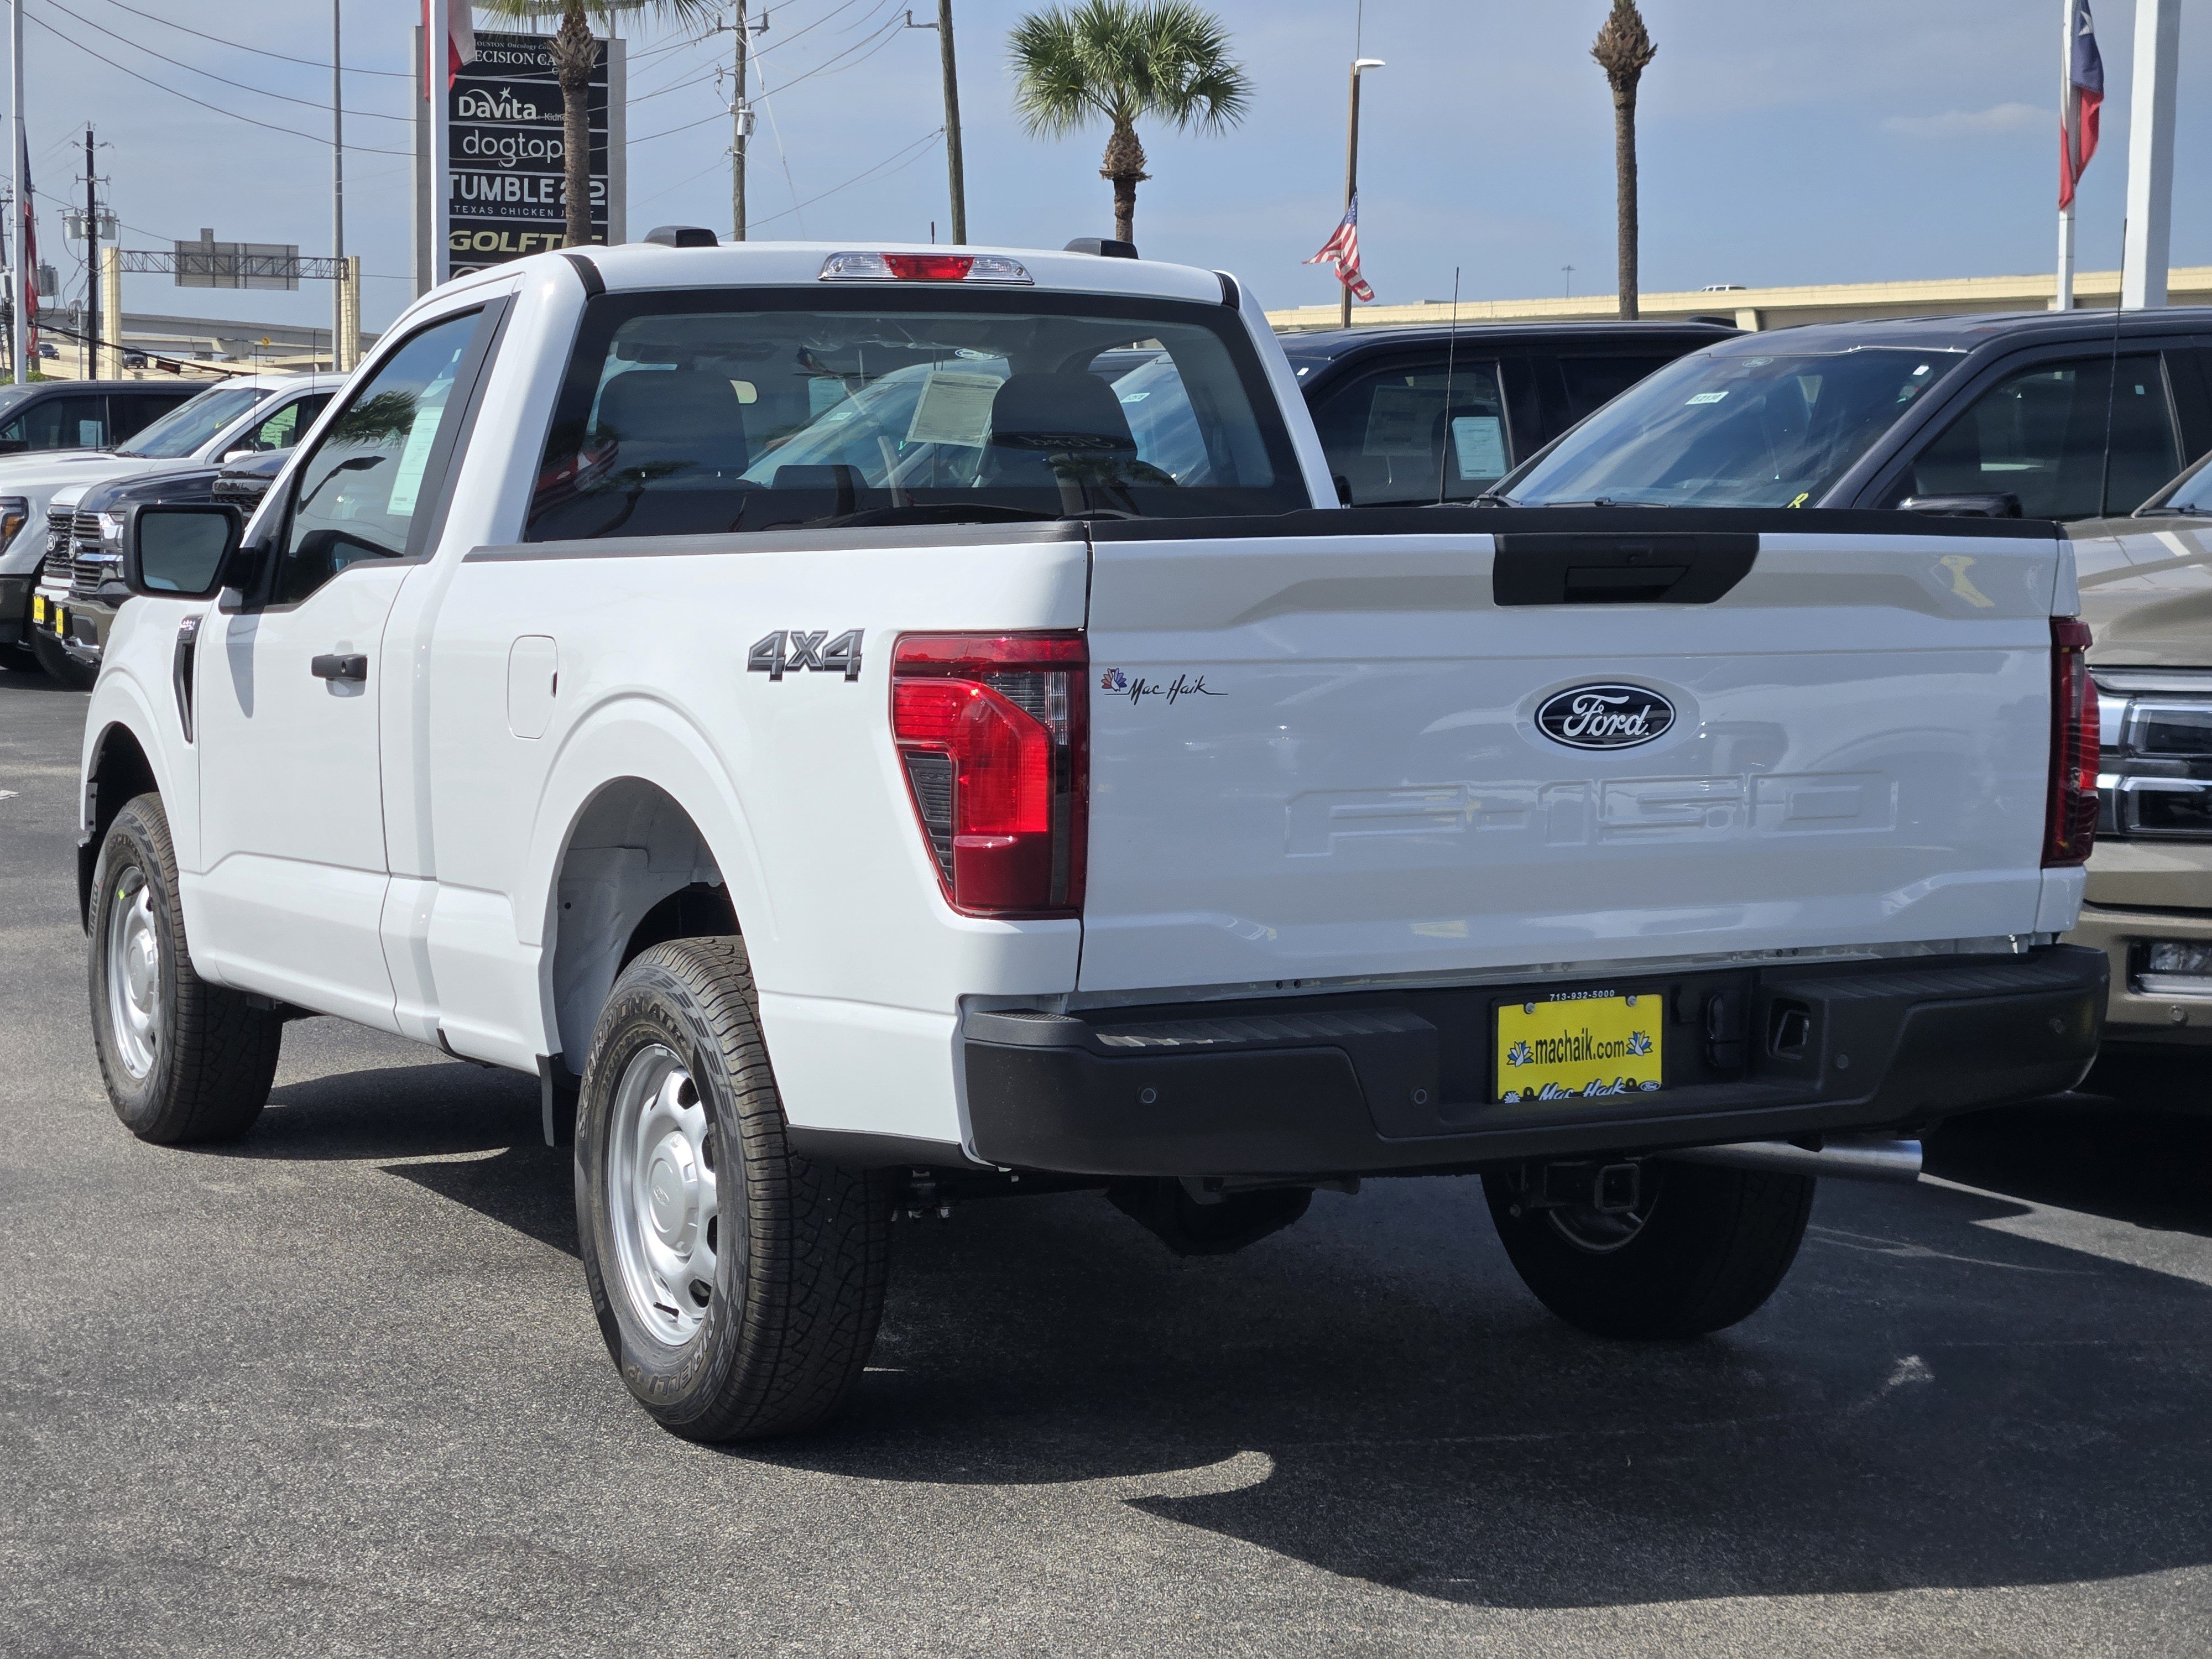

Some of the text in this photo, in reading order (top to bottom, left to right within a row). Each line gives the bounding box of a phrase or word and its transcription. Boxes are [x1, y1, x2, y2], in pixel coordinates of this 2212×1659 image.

[475, 50, 534, 65] ECISION
[508, 42, 536, 50] Oncology
[463, 129, 565, 168] dogtop
[449, 175, 554, 204] TUMBLE
[454, 205, 493, 215] TEXAS
[500, 207, 553, 217] CHICKEN
[449, 230, 602, 252] GOLFT
[1128, 674, 1211, 705] Mac Haik
[1563, 694, 1651, 737] Ford
[1550, 990, 1615, 1001] 713-932-5000
[1535, 1027, 1625, 1065] machaik.com
[1538, 1077, 1629, 1101] Mac Haik
